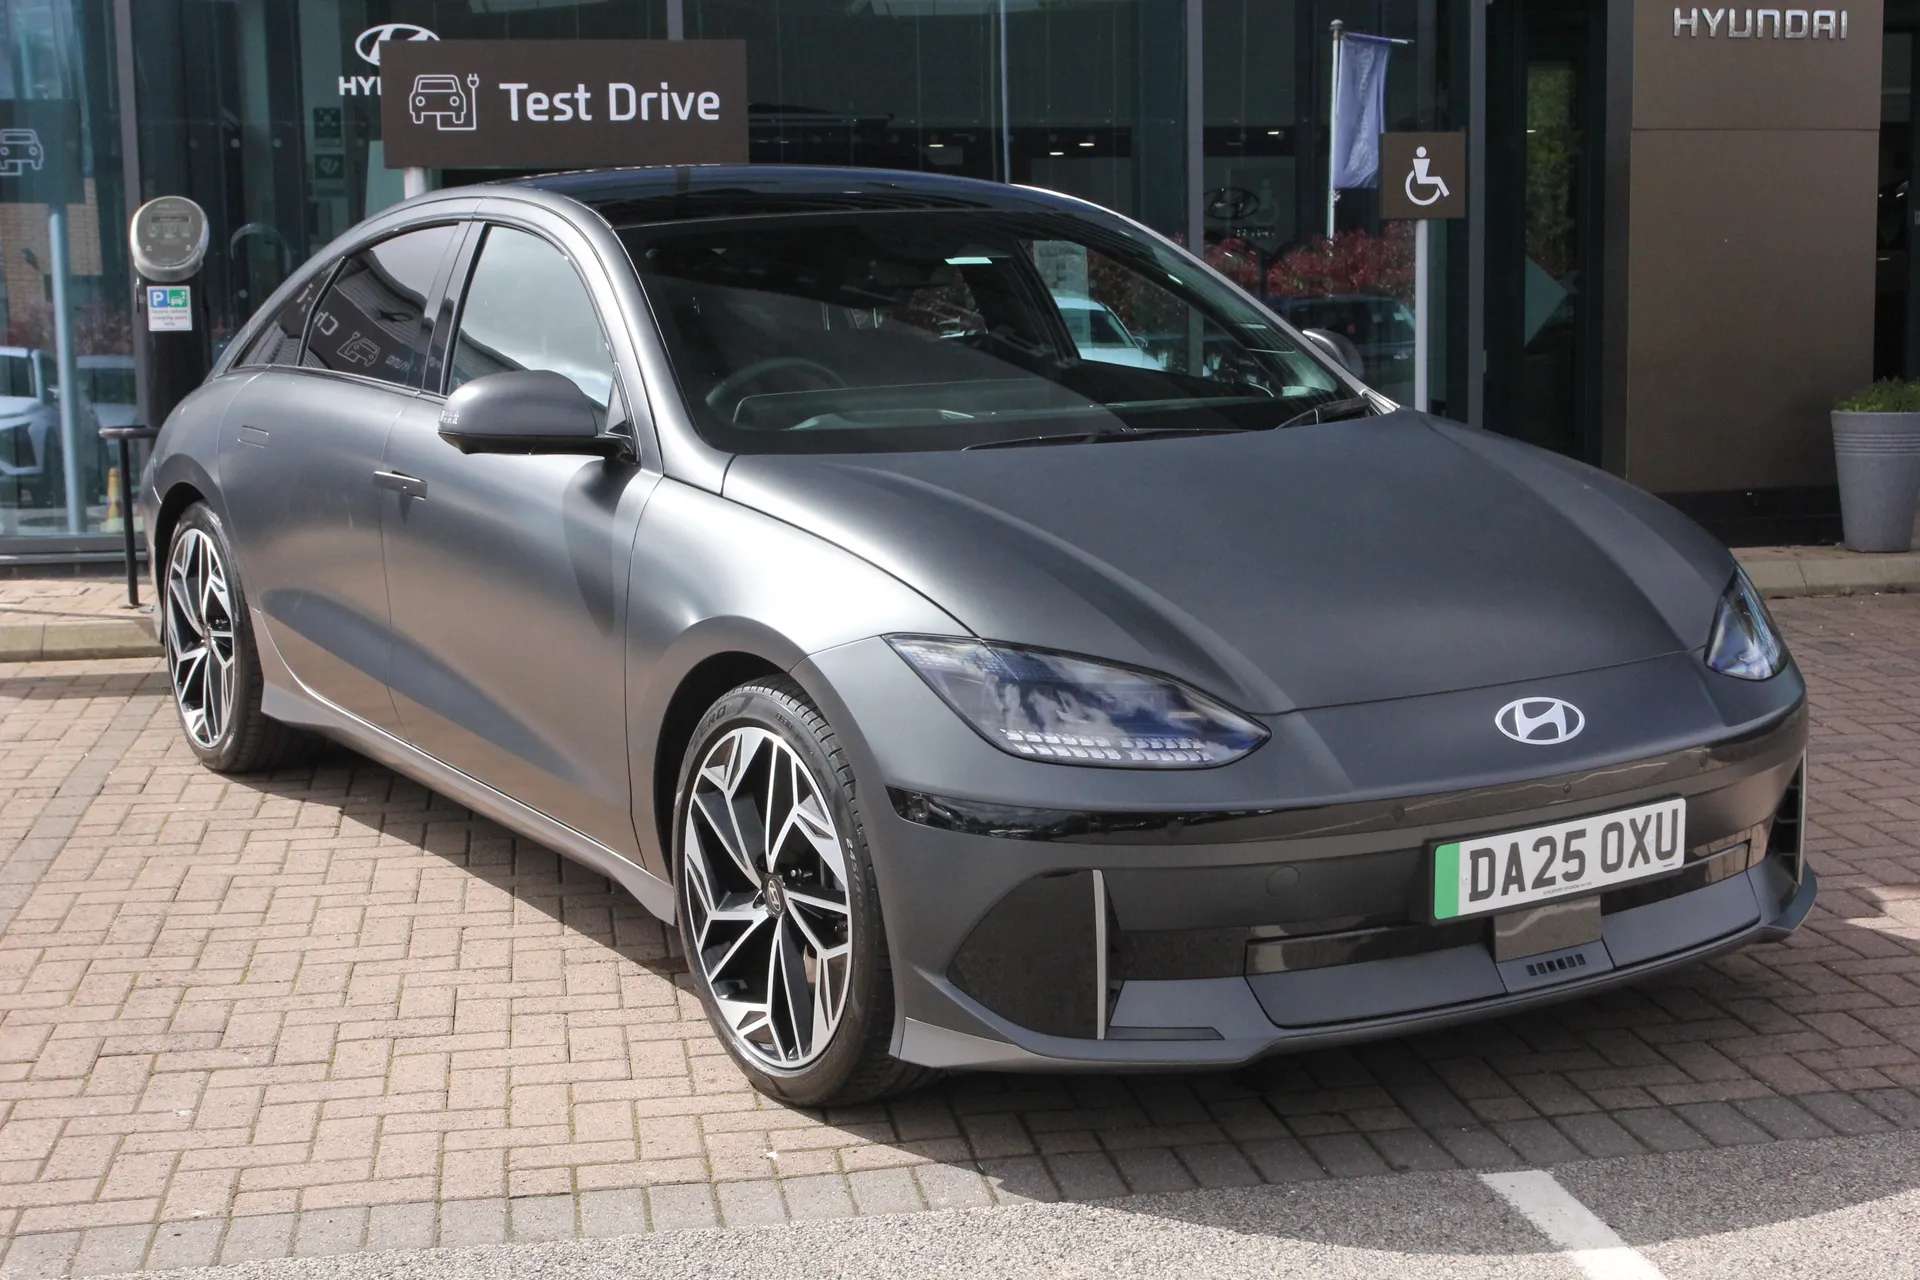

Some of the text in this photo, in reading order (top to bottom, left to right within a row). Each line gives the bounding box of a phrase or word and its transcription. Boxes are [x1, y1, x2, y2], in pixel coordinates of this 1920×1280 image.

[1673, 7, 1848, 39] HYUNDAI
[499, 81, 720, 122] Test Drive
[152, 291, 164, 306] P
[1468, 808, 1679, 902] DA25 OXU
